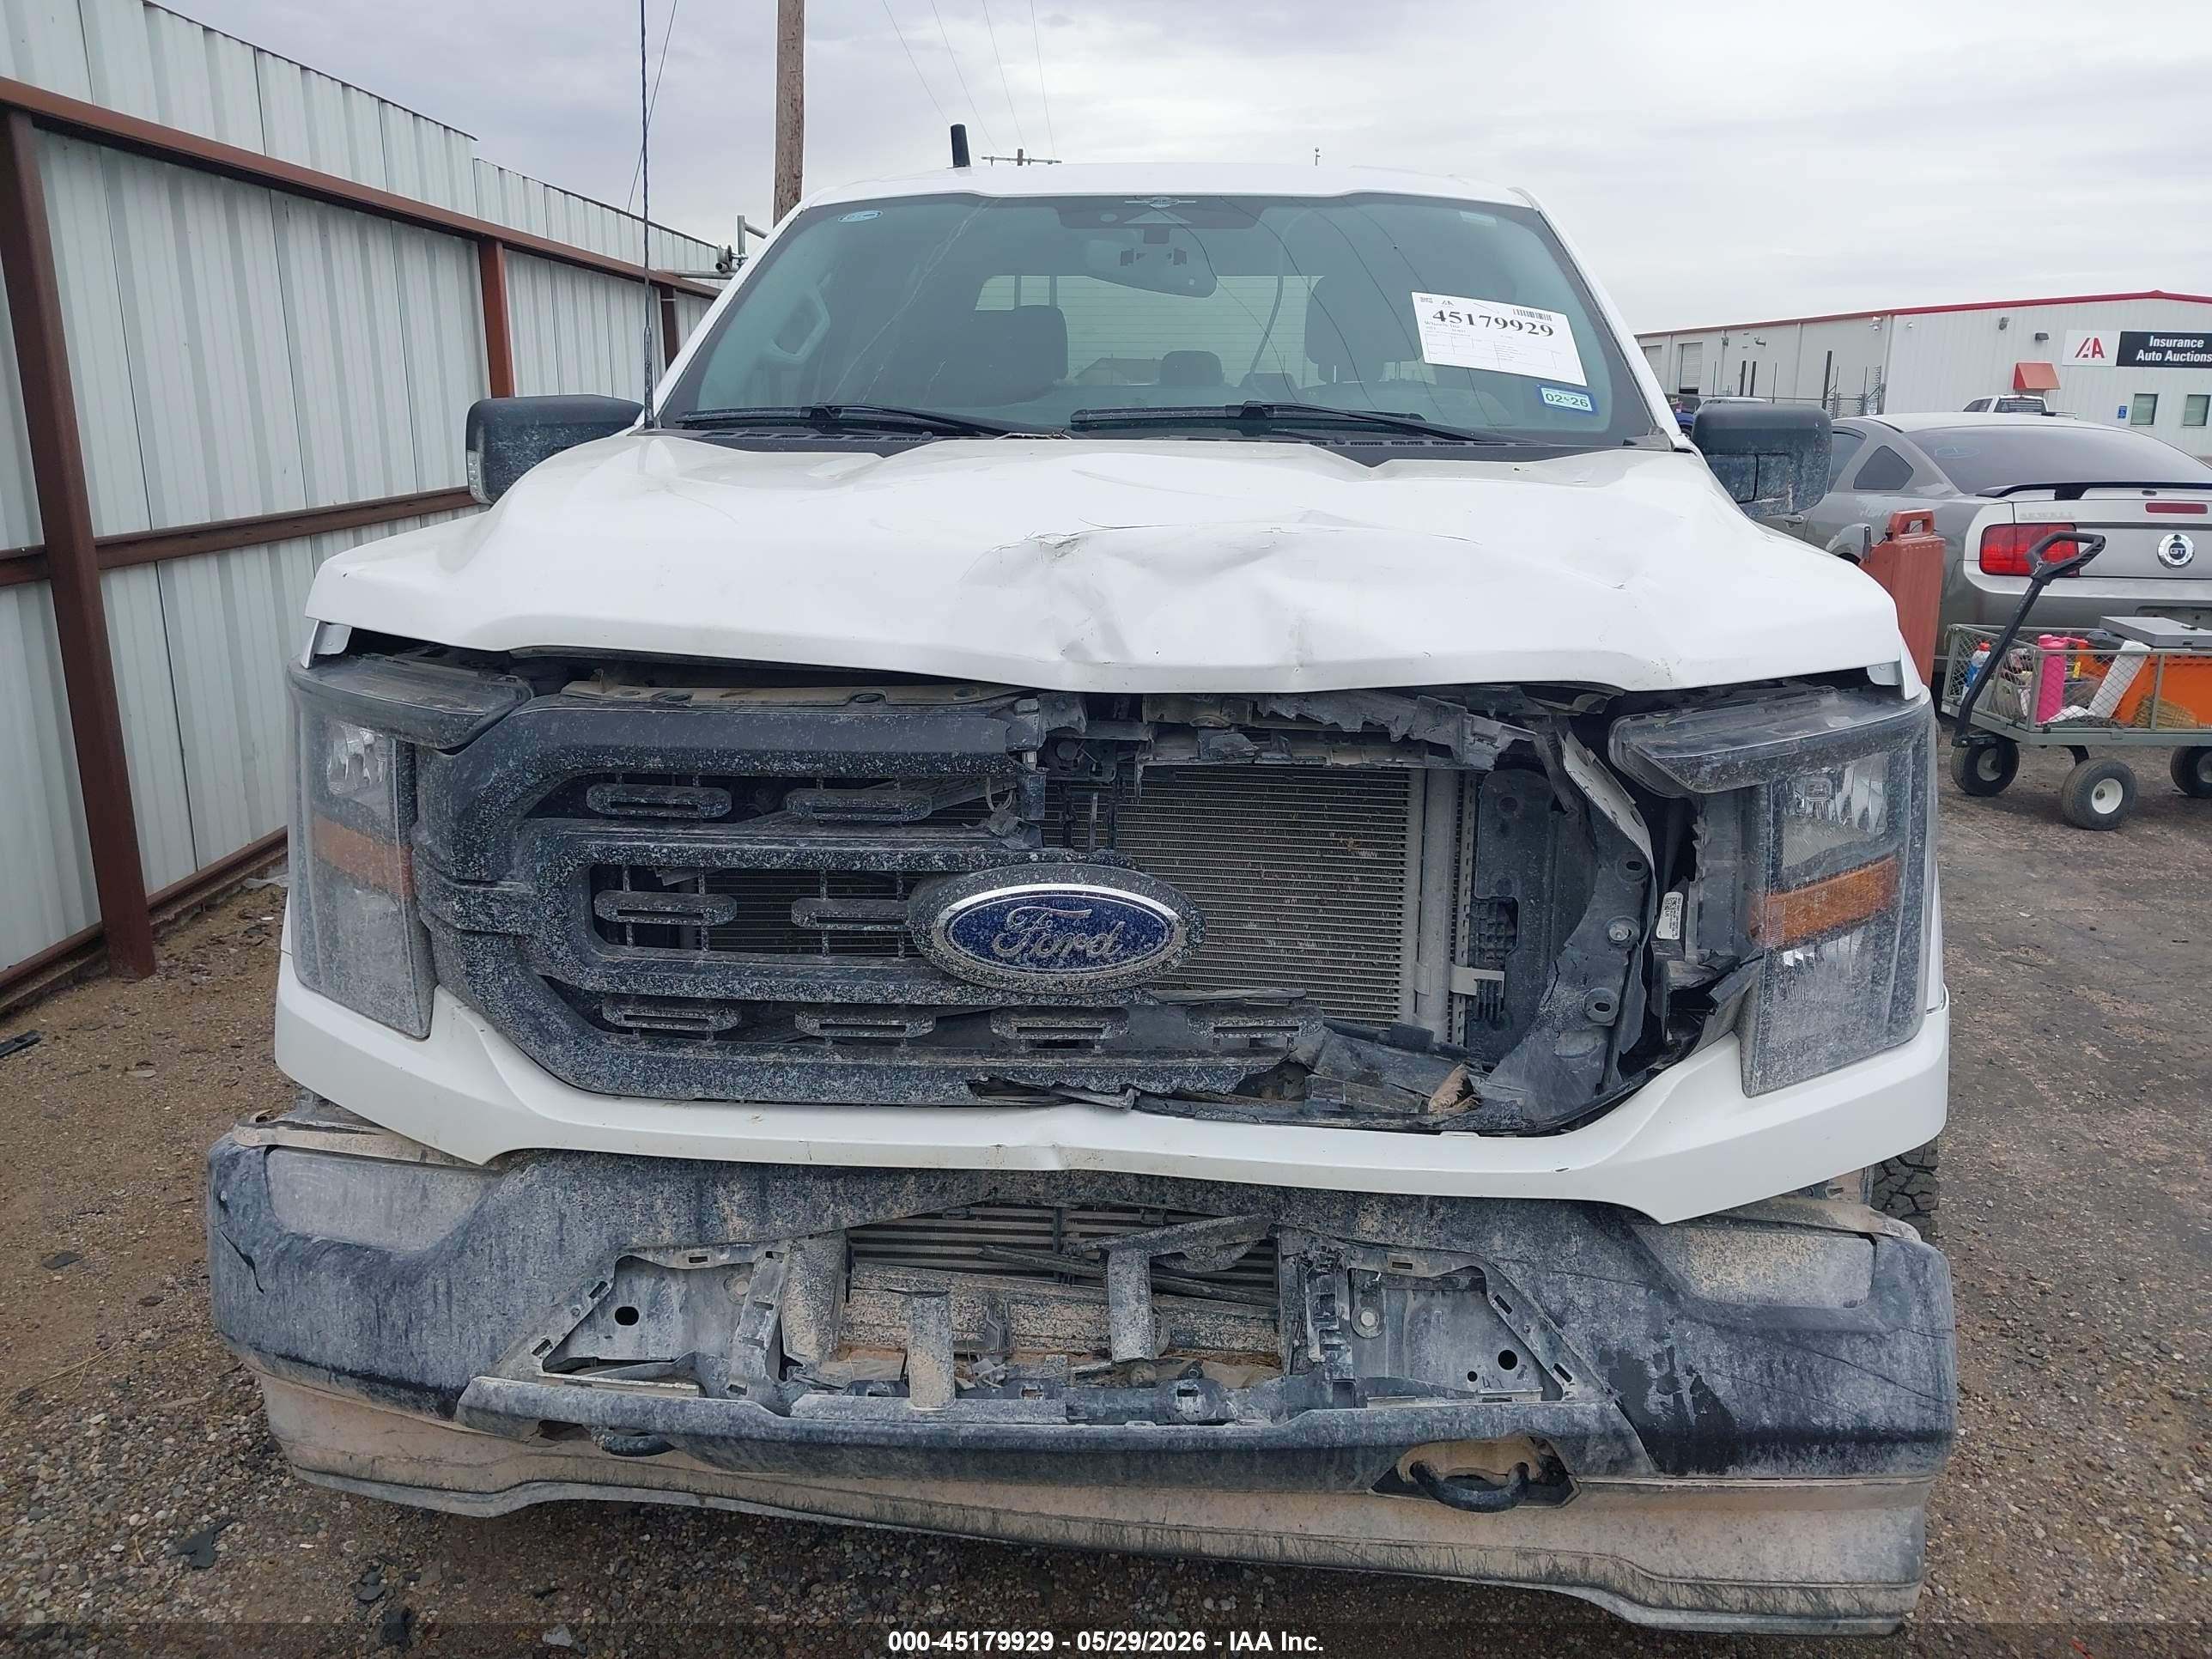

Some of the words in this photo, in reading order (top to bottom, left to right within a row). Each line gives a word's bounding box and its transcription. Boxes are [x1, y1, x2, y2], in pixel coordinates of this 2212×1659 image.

[1432, 309, 1554, 337] 45179929
[2149, 335, 2205, 348] Insurance
[2136, 349, 2161, 362] Auto
[2164, 350, 2212, 362] Auctions
[1545, 392, 1564, 404] 02
[1571, 397, 1589, 408] 26
[992, 906, 1125, 958] Ford
